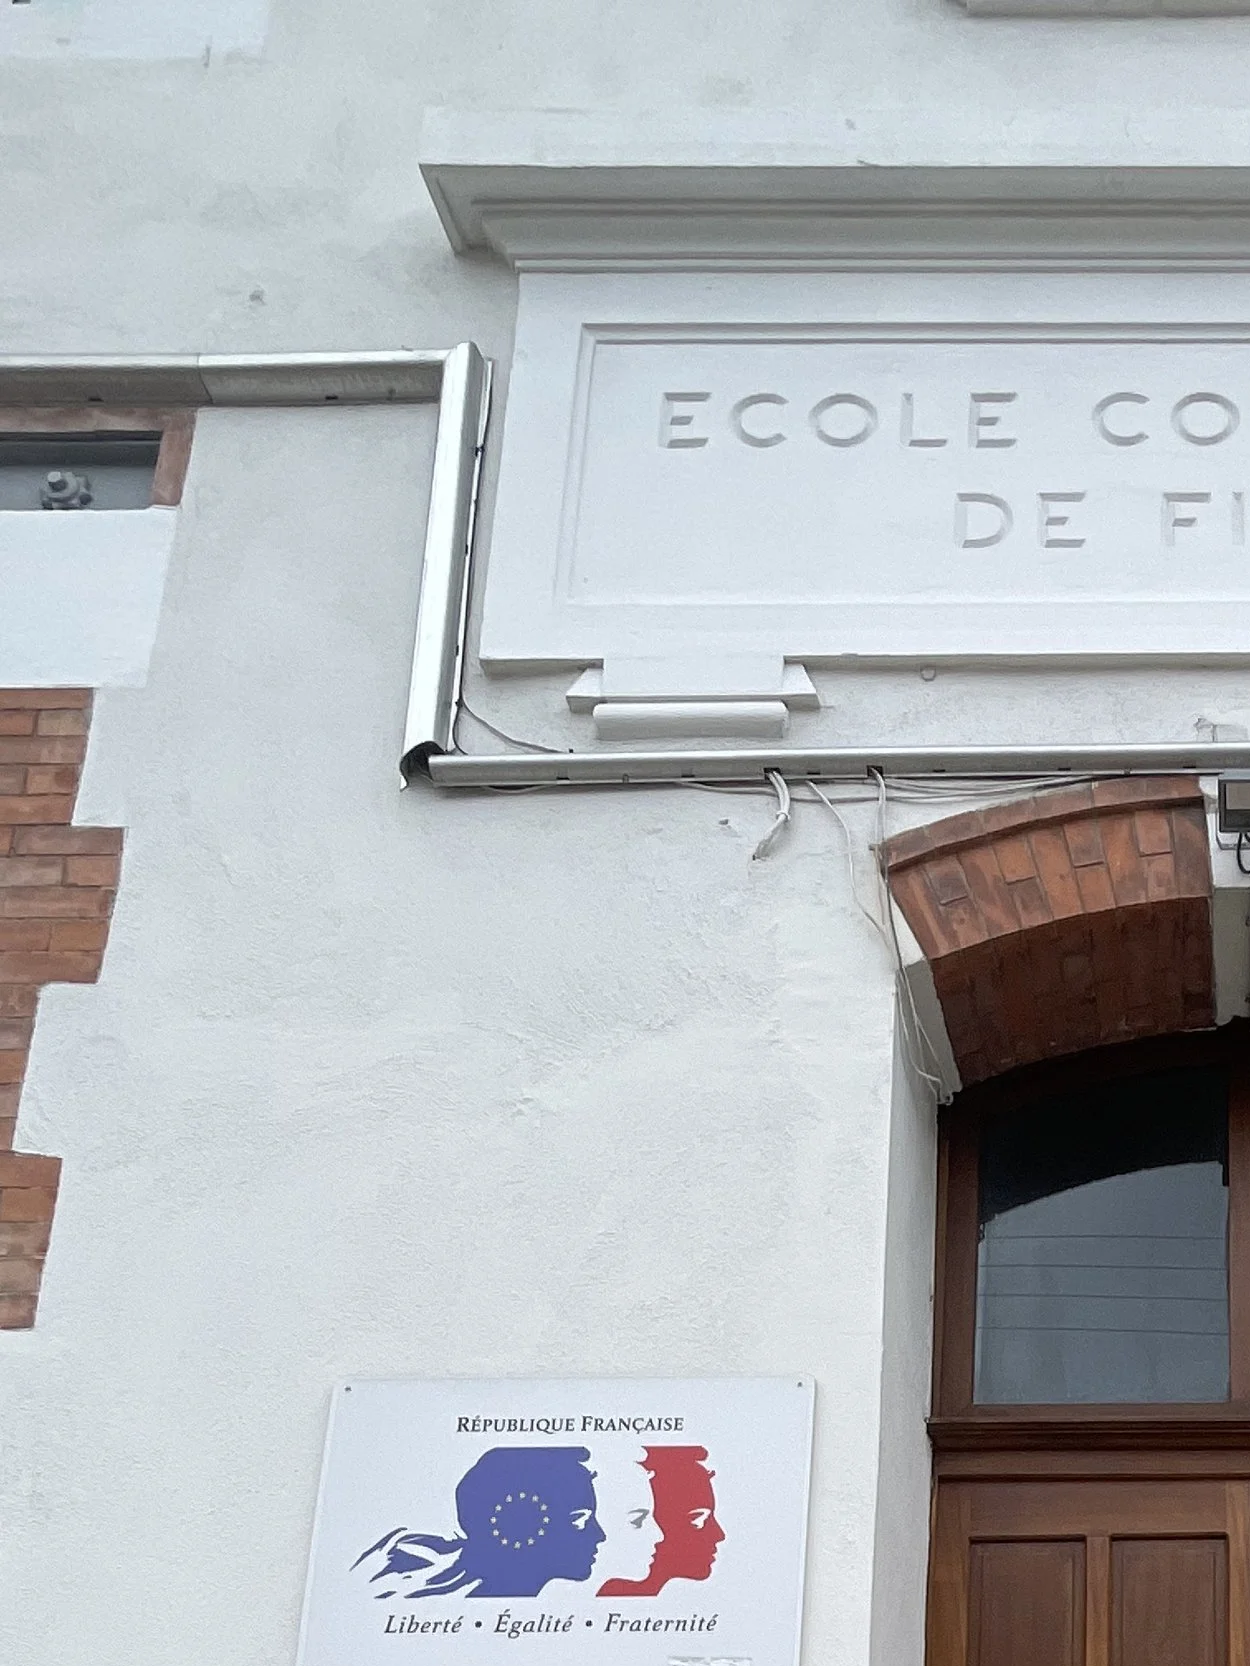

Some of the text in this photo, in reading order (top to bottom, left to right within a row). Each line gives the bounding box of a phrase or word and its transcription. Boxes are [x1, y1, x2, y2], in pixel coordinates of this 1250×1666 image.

[657, 391, 1018, 449] ECOLE
[953, 491, 1088, 549] DE
[456, 1415, 684, 1435] RÉPUBLIQUE FRANÇAISE
[384, 1609, 720, 1639] Liberté Égalité Fraternité
